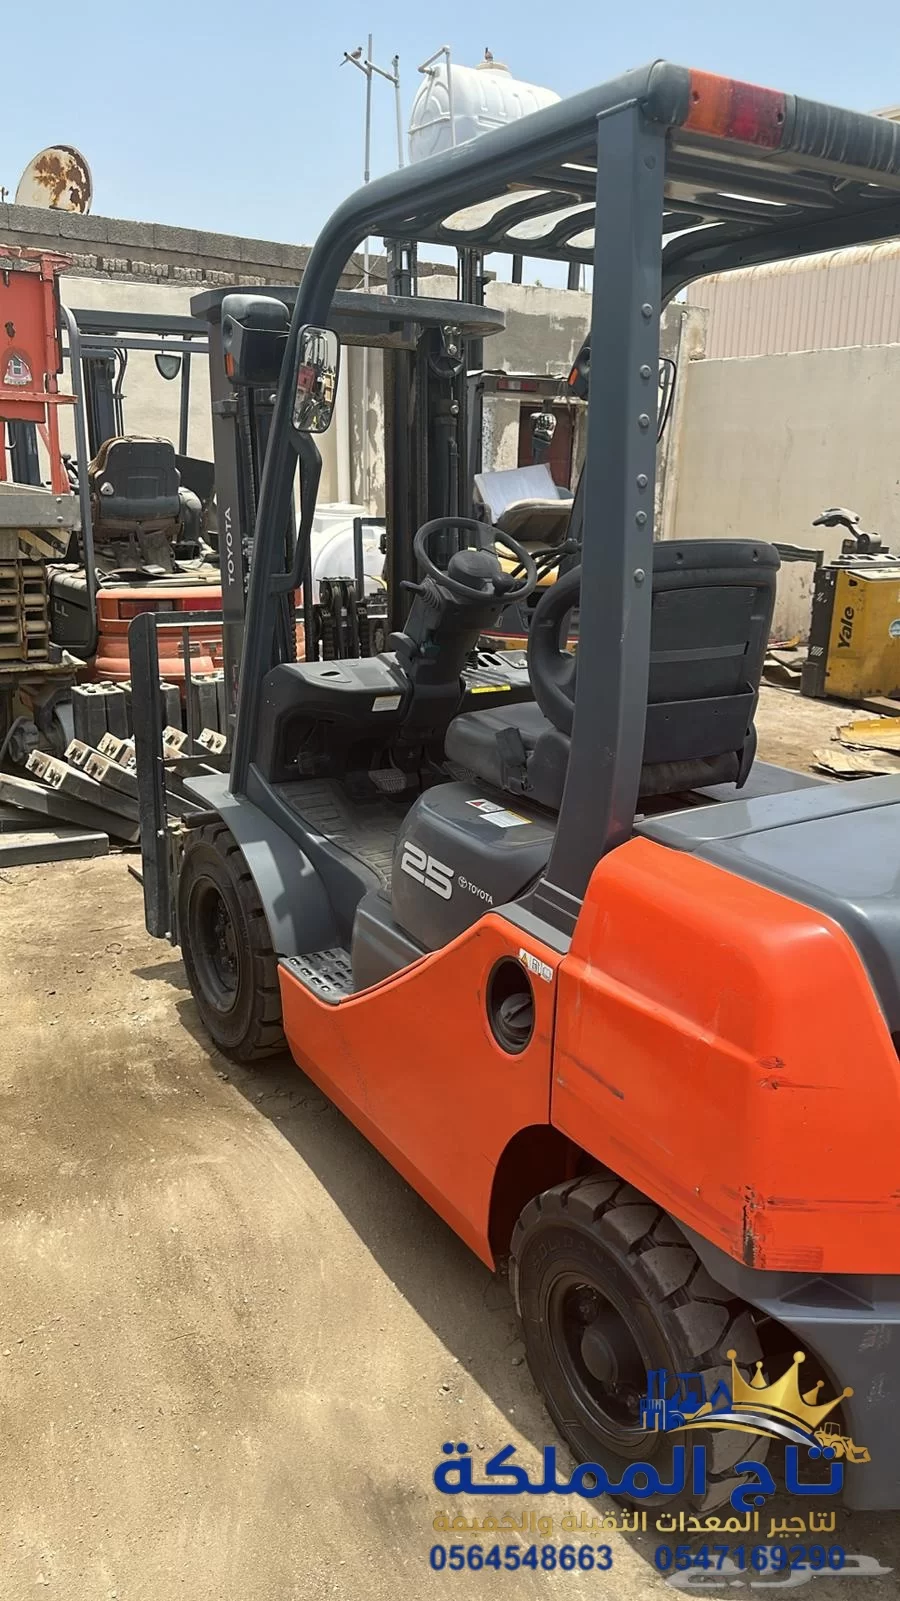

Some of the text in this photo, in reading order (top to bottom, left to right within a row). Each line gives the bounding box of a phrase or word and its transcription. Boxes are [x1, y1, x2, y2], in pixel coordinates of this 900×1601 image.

[224, 506, 236, 586] TOYOTA
[837, 606, 855, 648] Yale
[401, 841, 455, 900] 25
[467, 881, 494, 905] TOYOTA
